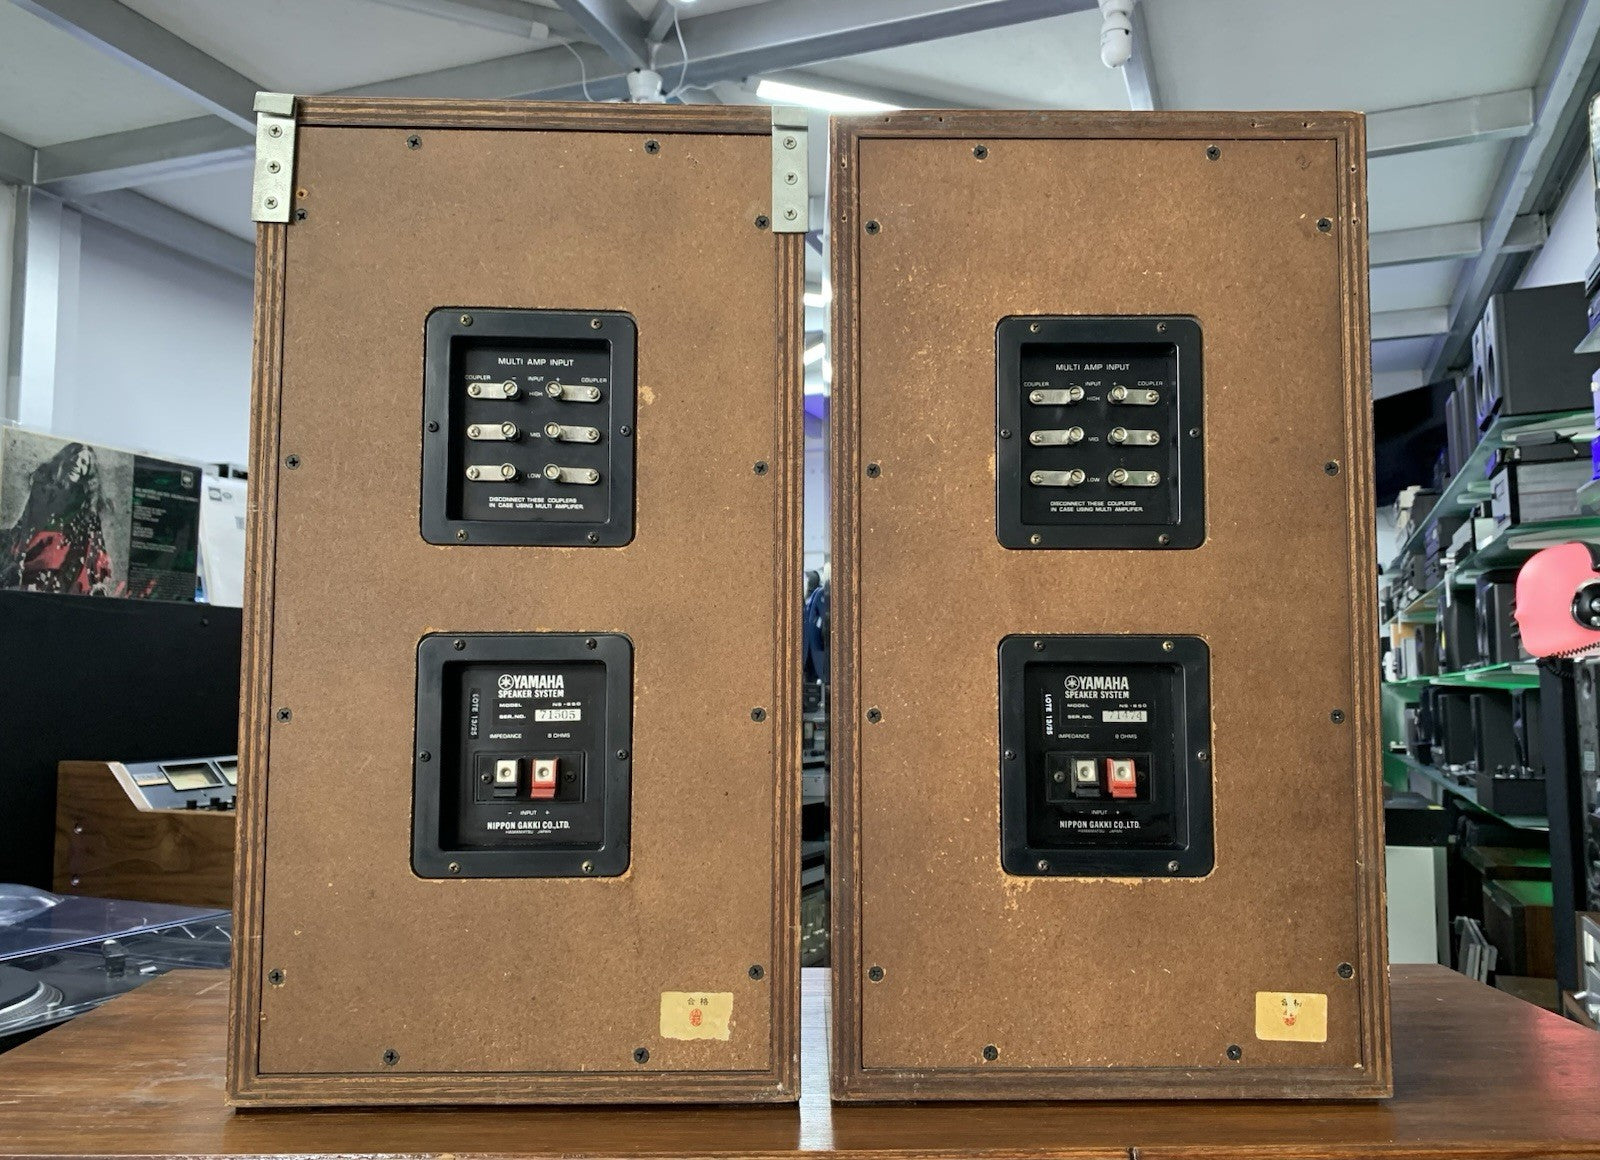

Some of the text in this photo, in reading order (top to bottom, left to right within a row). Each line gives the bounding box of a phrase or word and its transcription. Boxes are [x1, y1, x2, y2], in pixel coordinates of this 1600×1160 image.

[514, 675, 564, 689] YAMAHA
[1079, 676, 1129, 690] YAMAHA
[498, 690, 532, 698] SPEAKER
[540, 710, 576, 720] 71505
[487, 822, 515, 830] NIPPON
